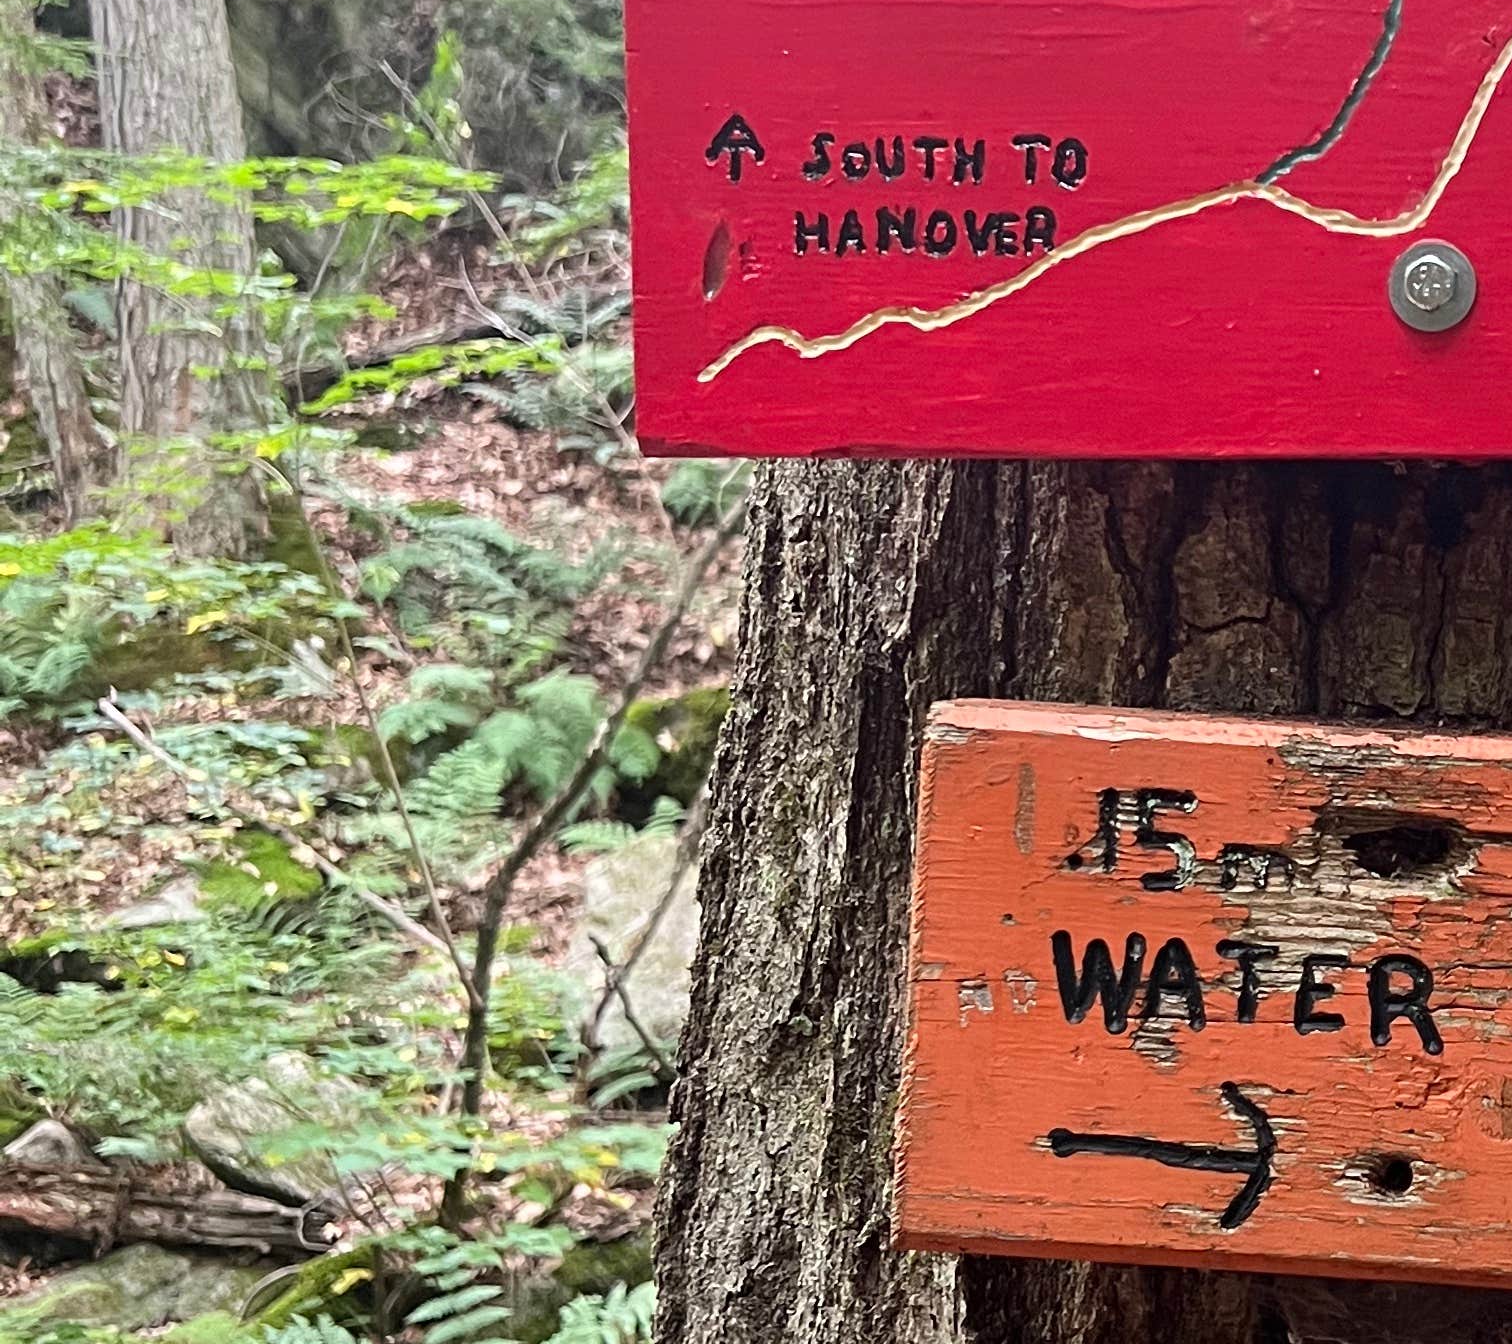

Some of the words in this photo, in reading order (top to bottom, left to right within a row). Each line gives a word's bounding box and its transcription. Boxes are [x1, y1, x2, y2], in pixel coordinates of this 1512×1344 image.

[802, 132, 986, 185] SOUTH
[1011, 133, 1088, 191] TO
[794, 204, 1057, 256] HANOVER
[1050, 930, 1445, 1056] WATER
